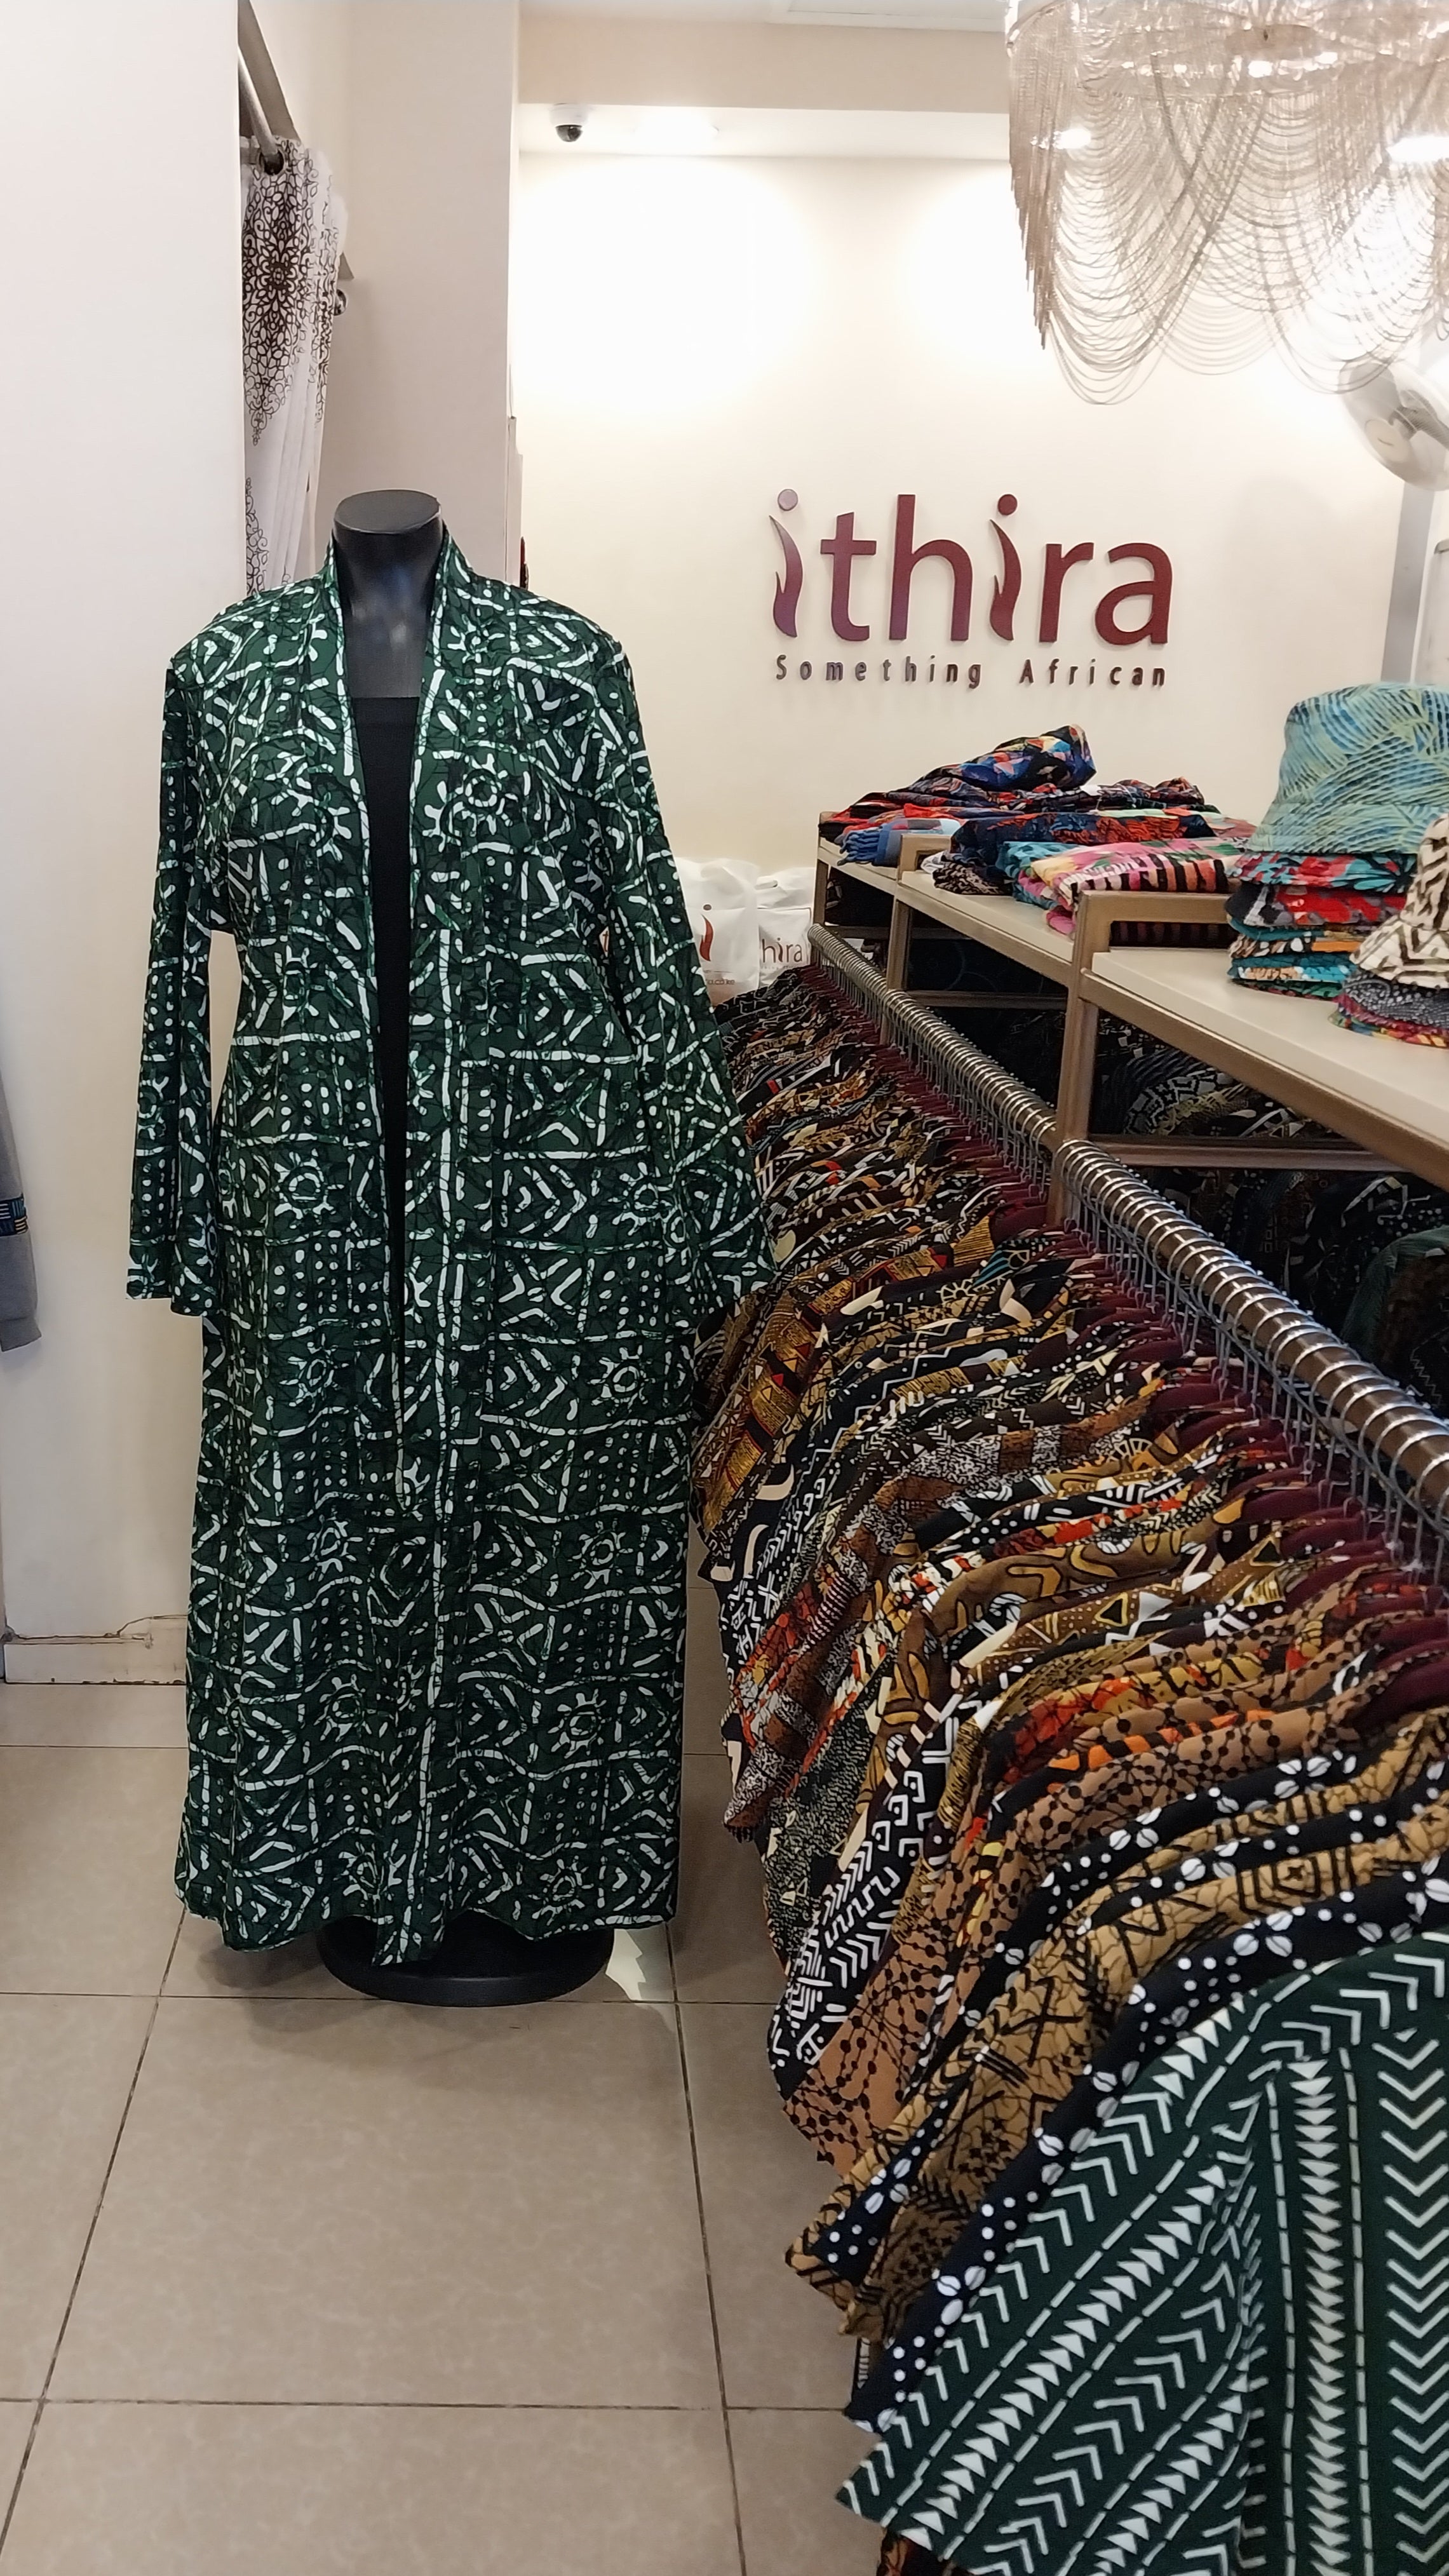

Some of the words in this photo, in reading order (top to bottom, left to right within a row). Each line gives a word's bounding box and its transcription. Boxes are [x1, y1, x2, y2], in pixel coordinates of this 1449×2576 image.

[769, 489, 1173, 645] ithira
[776, 654, 981, 689] Something
[1018, 658, 1166, 687] African
[762, 937, 803, 963] hira
